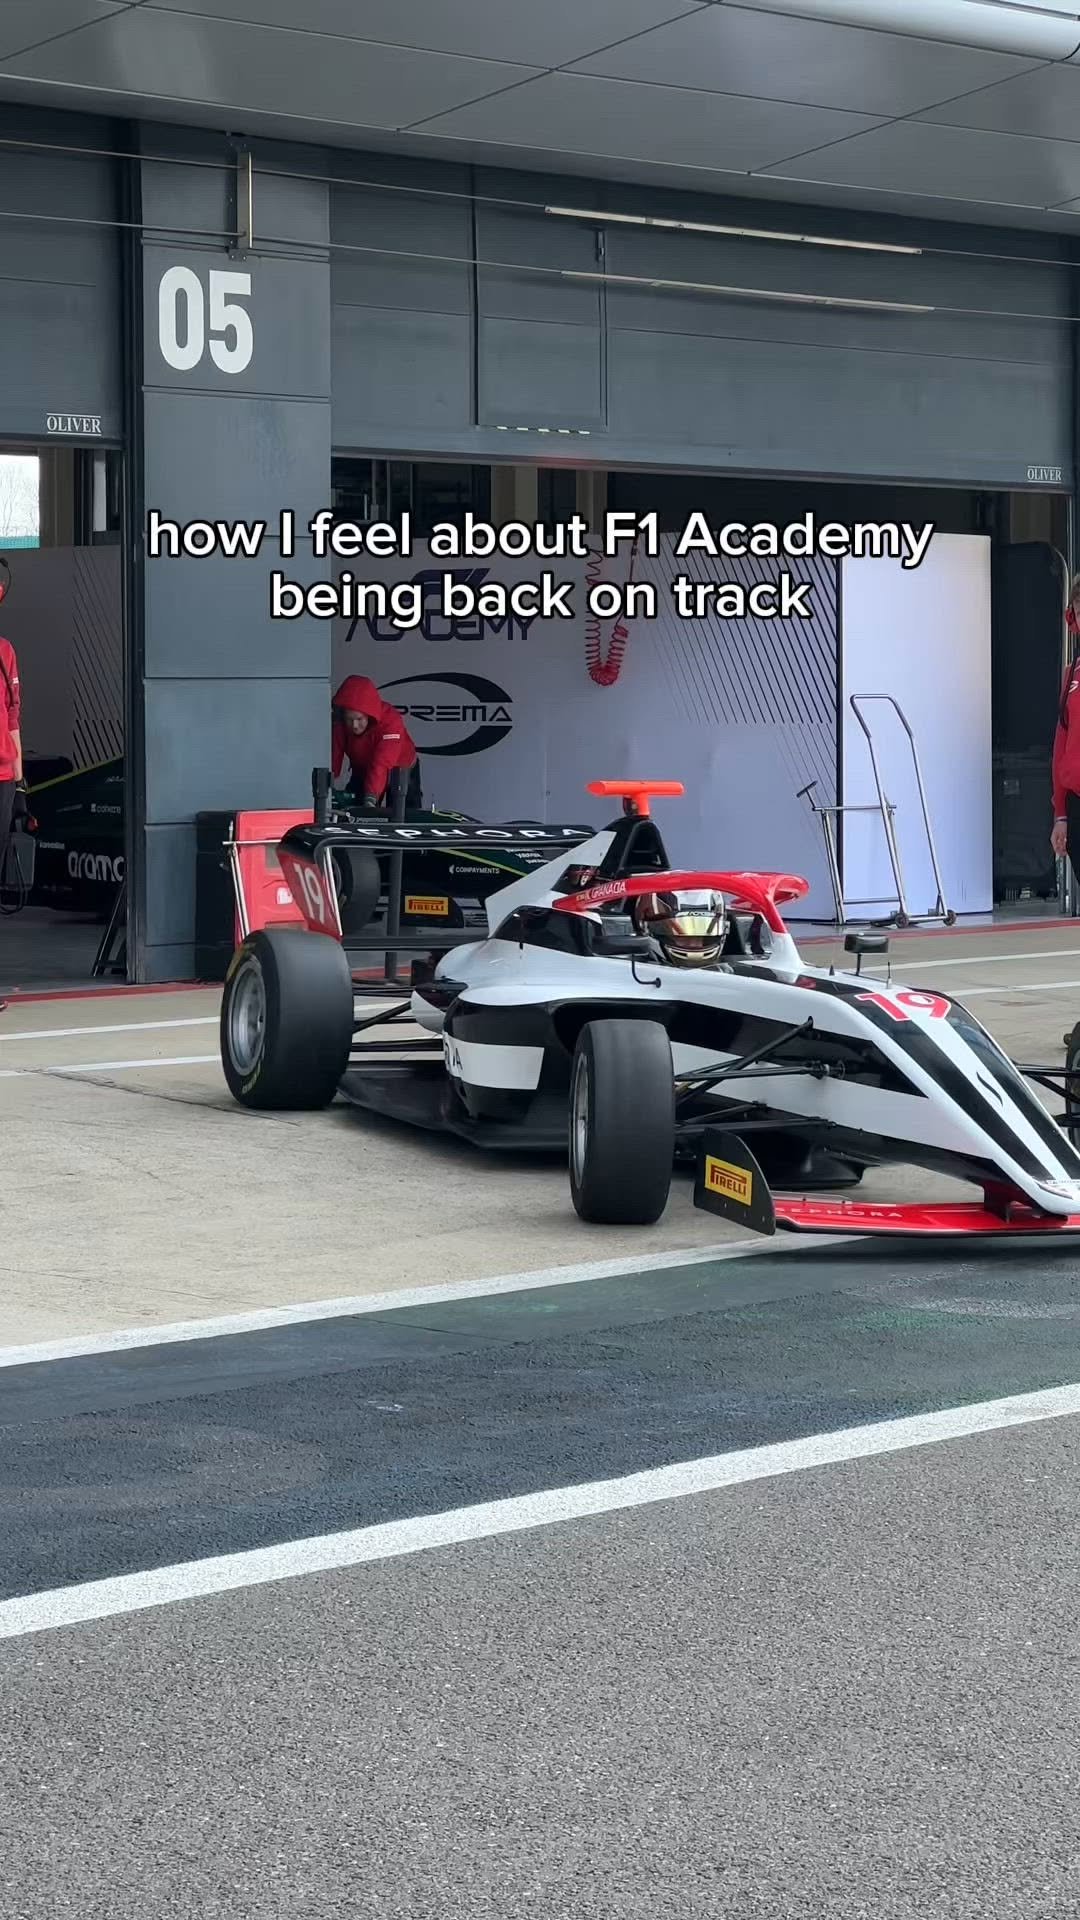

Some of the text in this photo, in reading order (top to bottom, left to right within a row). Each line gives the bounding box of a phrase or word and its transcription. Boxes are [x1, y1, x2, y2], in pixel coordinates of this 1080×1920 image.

[158, 266, 254, 375] 05
[46, 415, 102, 434] OLIVER
[1027, 468, 1062, 481] OLIVER
[323, 826, 593, 840] SEPHORA
[68, 851, 125, 882] aramc
[292, 862, 326, 925] 19
[408, 899, 444, 911] PIRELLI
[855, 991, 951, 1022] 19
[710, 1163, 748, 1197] PIRELLI
